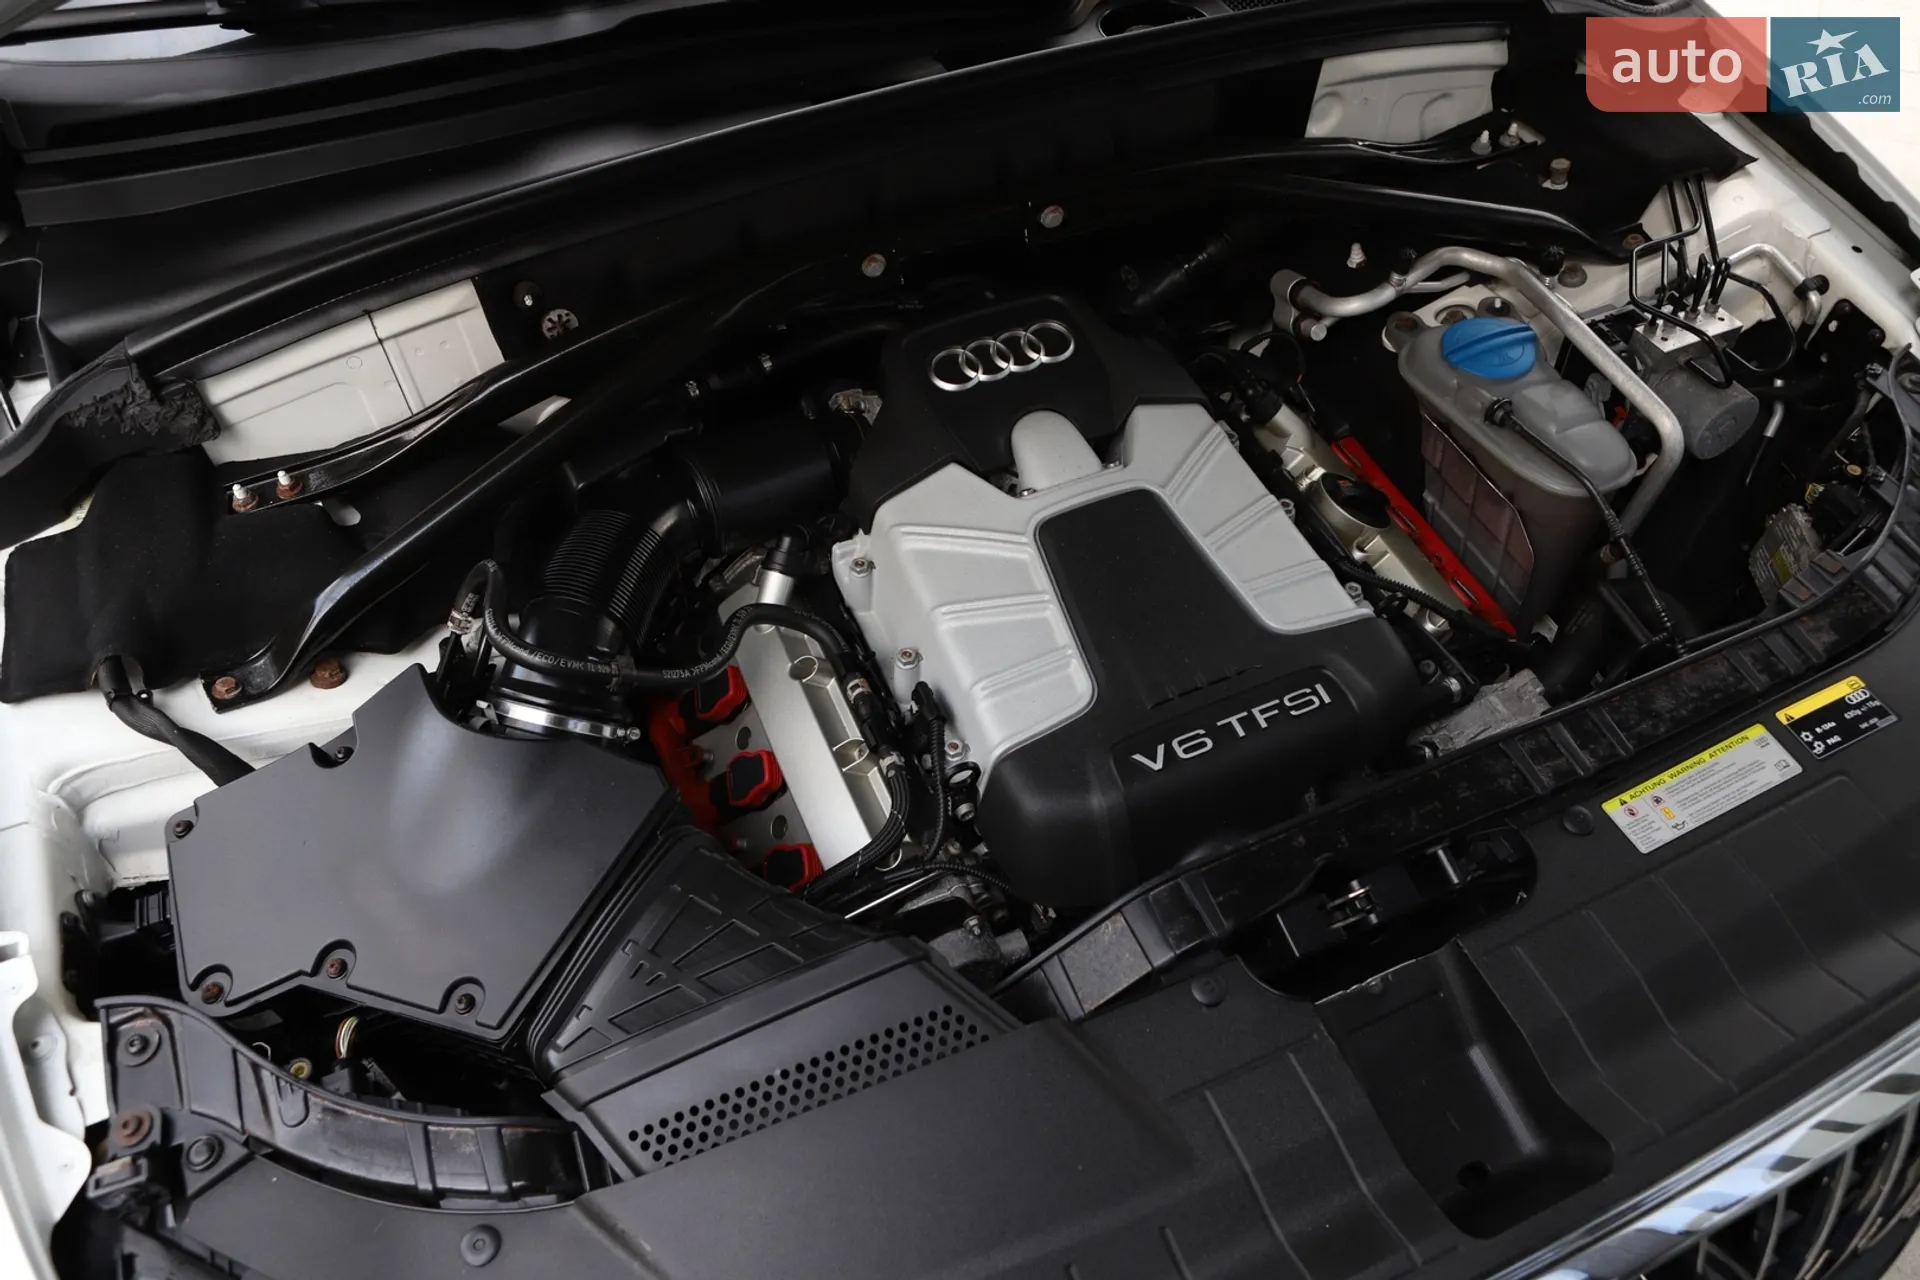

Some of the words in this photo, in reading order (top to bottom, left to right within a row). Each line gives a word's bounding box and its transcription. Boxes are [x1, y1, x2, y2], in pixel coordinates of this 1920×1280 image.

[1131, 728, 1214, 772] V6
[1216, 683, 1332, 738] TFSI
[1628, 778, 1667, 801] ACHTUNG
[1668, 757, 1707, 780] WARNING
[1708, 735, 1750, 760] ATTENTION
